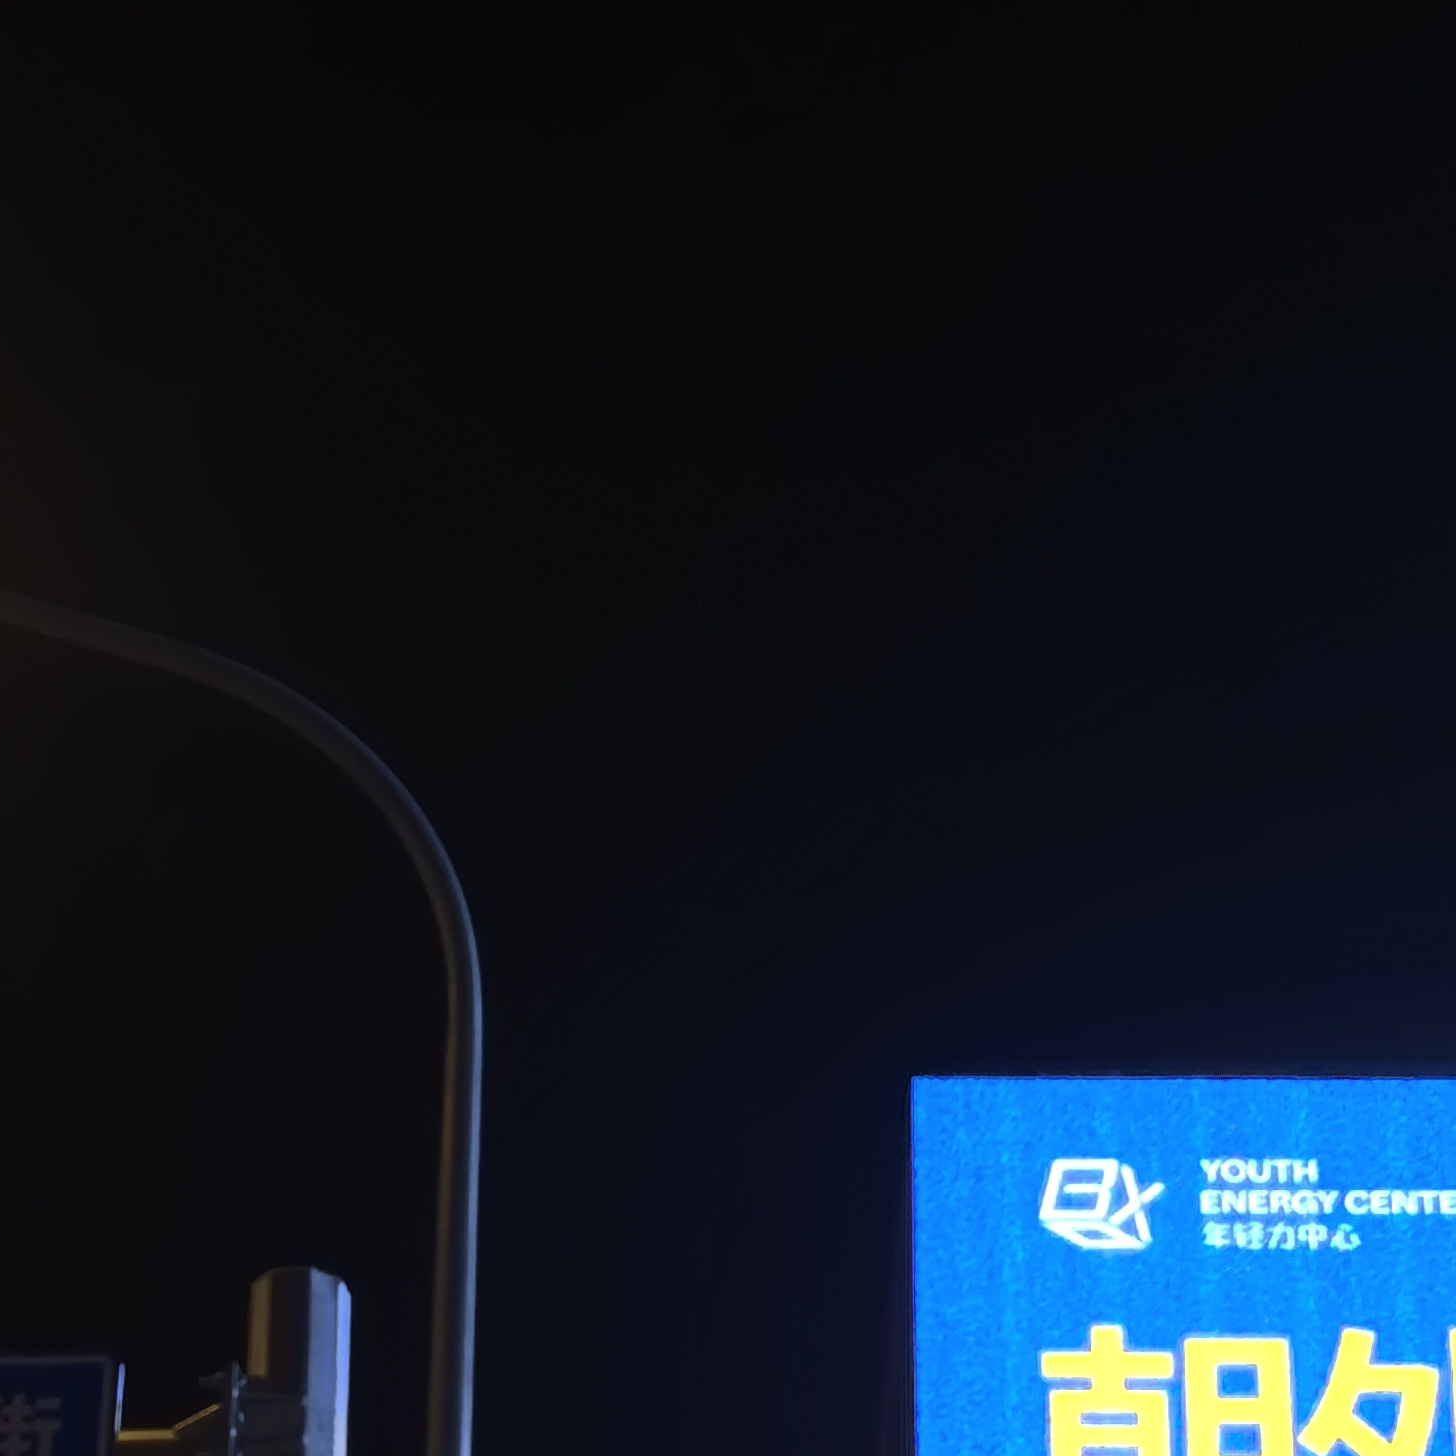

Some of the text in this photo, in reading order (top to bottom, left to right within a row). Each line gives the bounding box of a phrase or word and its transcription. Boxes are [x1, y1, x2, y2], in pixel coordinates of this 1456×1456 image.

[1200, 1157, 1318, 1185] YOUTH
[1199, 1189, 1340, 1216] ENERGY
[1200, 1220, 1362, 1251] 年轻力中心
